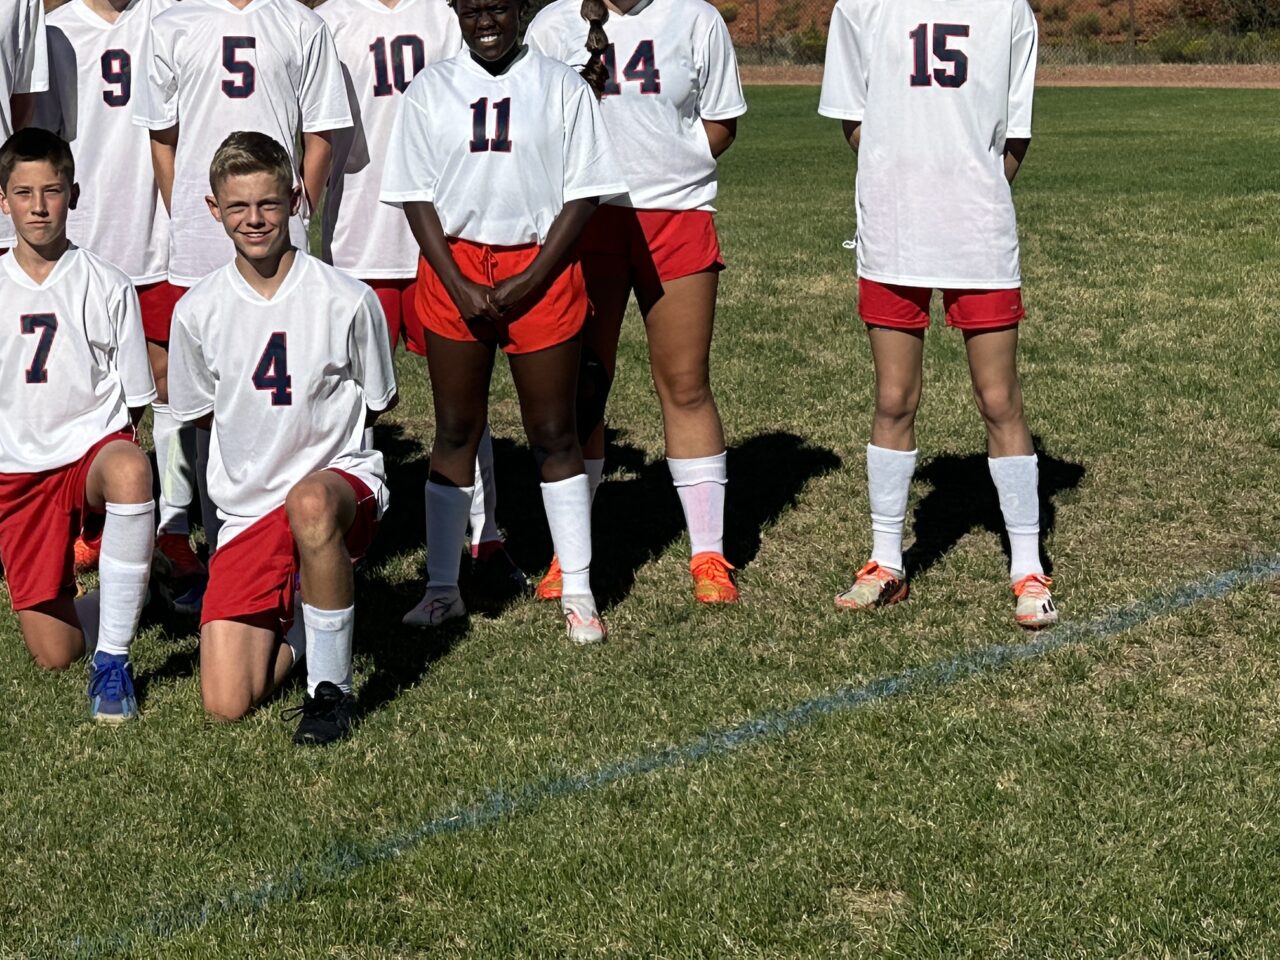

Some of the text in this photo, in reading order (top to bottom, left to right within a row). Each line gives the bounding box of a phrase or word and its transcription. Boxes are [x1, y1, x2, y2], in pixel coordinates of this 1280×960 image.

[100, 48, 132, 108] 9
[221, 36, 256, 99] 5
[369, 34, 425, 98] 10
[600, 39, 661, 96] 14
[909, 23, 970, 89] 15
[469, 97, 512, 153] 11
[20, 313, 59, 384] 7
[251, 331, 292, 406] 4
